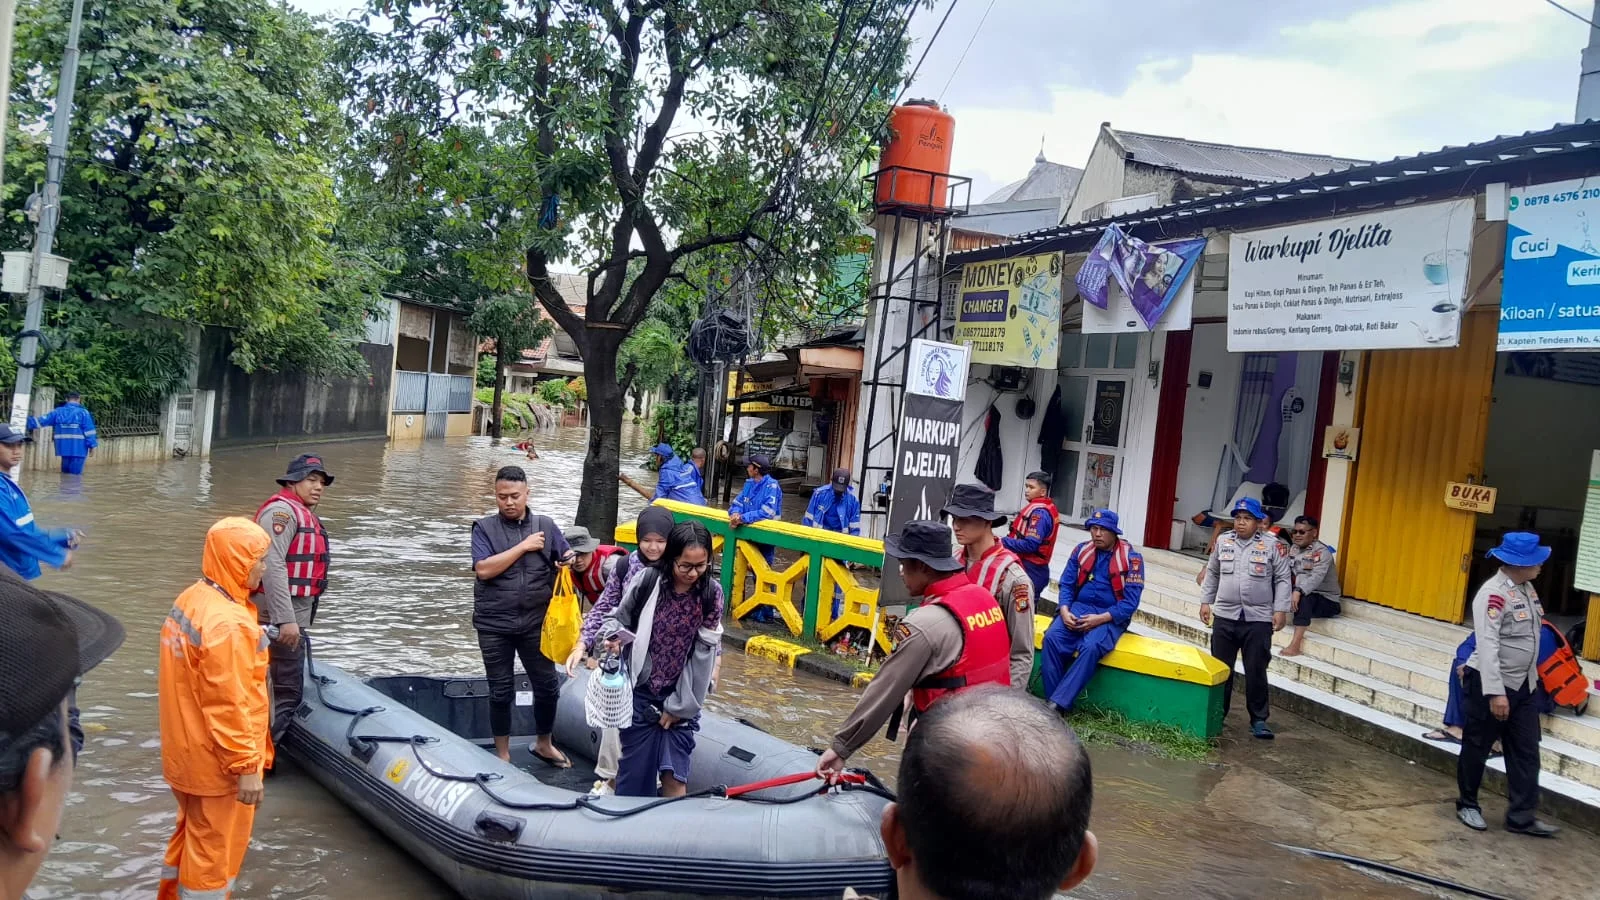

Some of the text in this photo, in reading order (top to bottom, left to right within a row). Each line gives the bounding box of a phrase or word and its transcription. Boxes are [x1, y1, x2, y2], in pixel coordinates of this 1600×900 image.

[1524, 195, 1550, 207] 0878
[1552, 191, 1579, 202] 4576
[1244, 222, 1392, 263] Warkupi Djelita
[1518, 237, 1550, 252] Cuci
[964, 262, 1015, 288] MONEY
[1298, 273, 1324, 281] Minuman:
[1274, 288, 1284, 297] Kopi
[1329, 284, 1338, 292] Teh
[1340, 282, 1356, 290] Panas
[963, 298, 1004, 314] CHANGER
[1301, 298, 1316, 306] Panas
[1296, 312, 1322, 320] Makanan:
[1500, 306, 1544, 320] Kiloan
[1288, 326, 1310, 334] Kentang
[1366, 322, 1378, 330] Roti
[1380, 320, 1398, 330] Bakar
[1508, 336, 1536, 346] Kapten
[1539, 336, 1574, 344] Tendean
[1576, 335, 1591, 343] No.
[904, 416, 960, 448] WARKUPI
[903, 451, 950, 478] DJELITA
[1452, 486, 1490, 502] BUKA
[966, 606, 1005, 631] POLISI
[403, 760, 474, 820] POLISI
